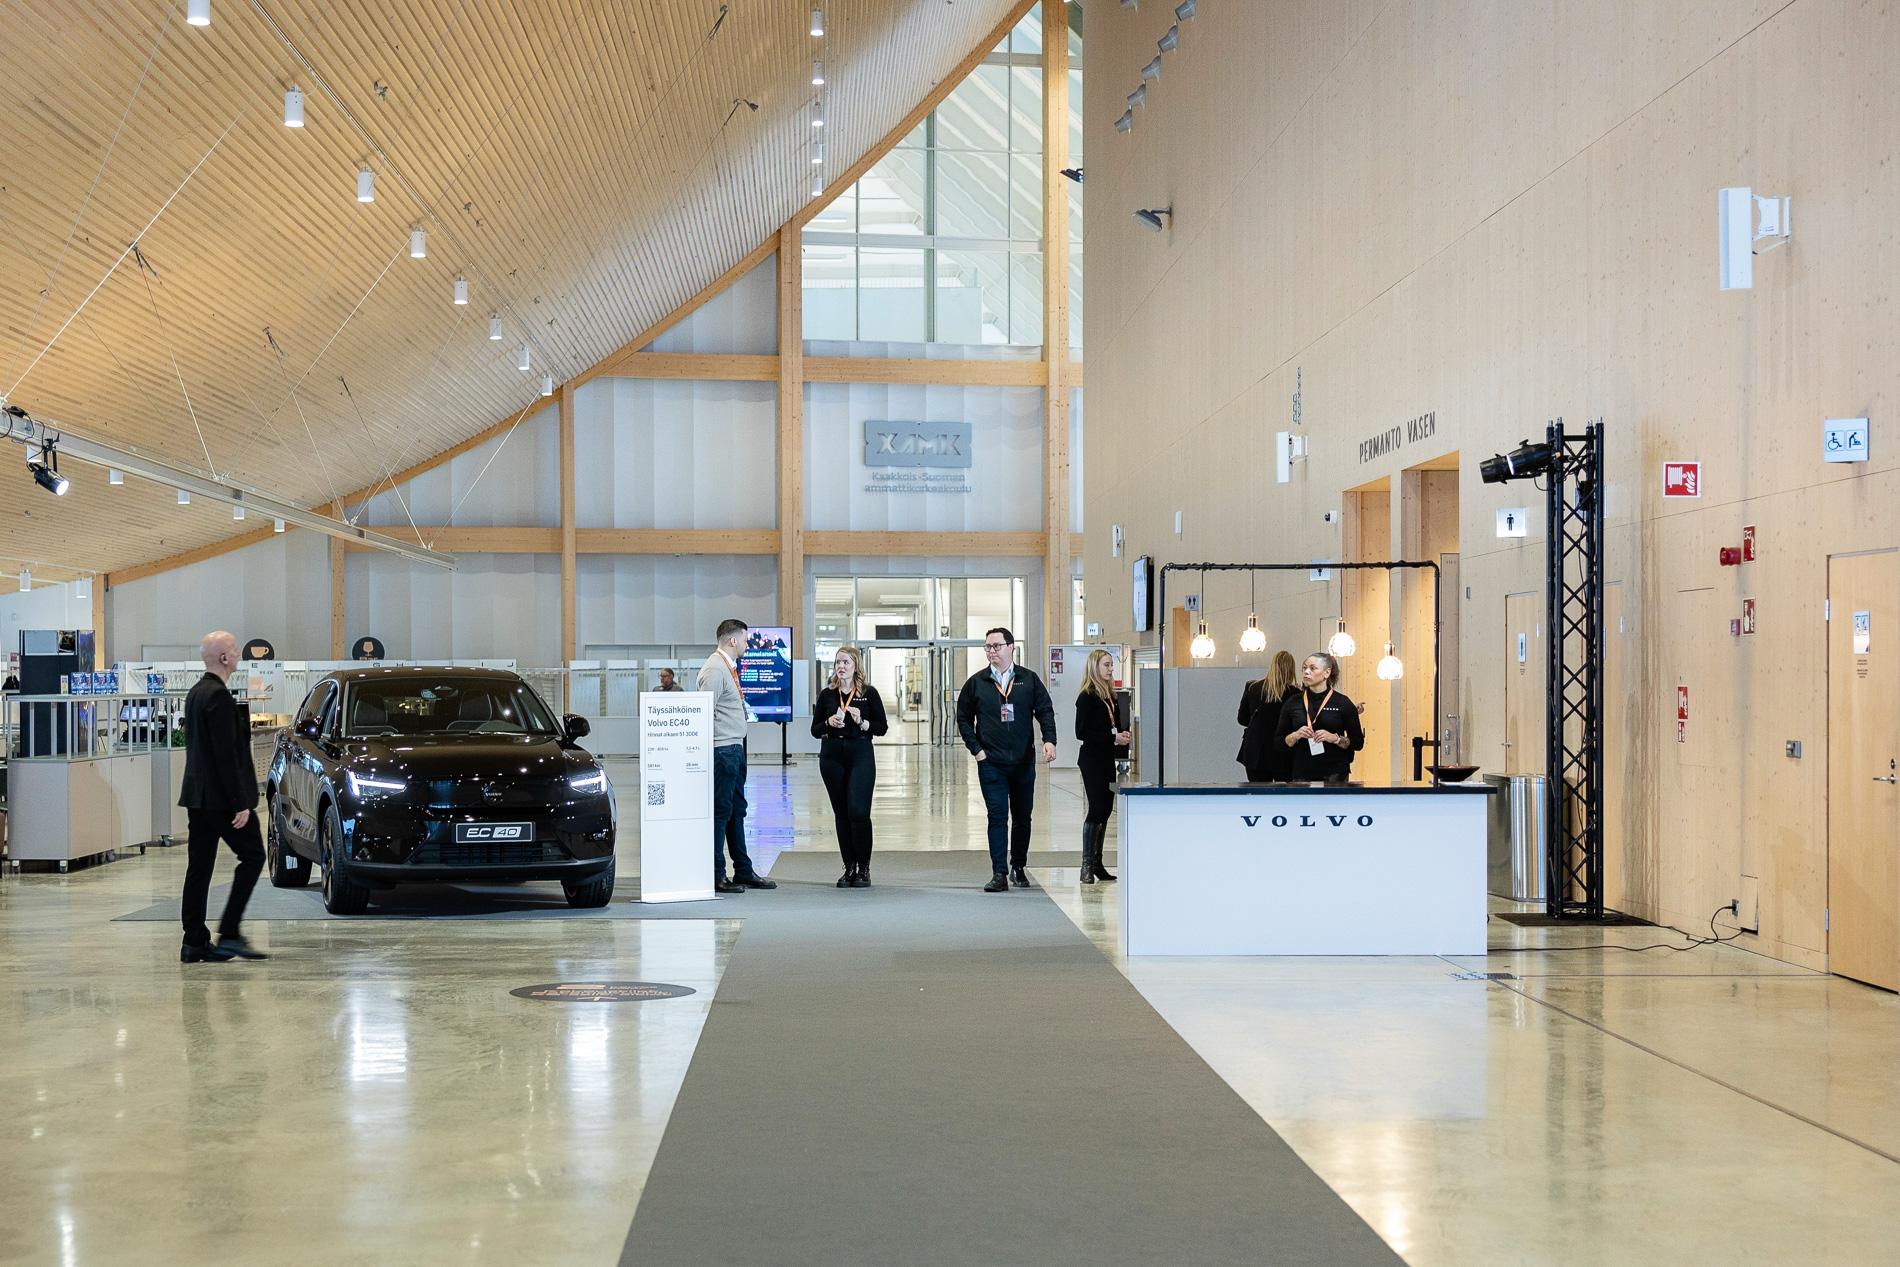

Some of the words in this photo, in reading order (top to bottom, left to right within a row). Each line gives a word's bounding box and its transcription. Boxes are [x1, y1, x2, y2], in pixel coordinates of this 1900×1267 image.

[876, 432, 962, 456] XAMK
[1359, 425, 1402, 465] PERMANTO
[1407, 411, 1435, 444] VASEN
[647, 705, 702, 716] Täyssähköinen
[647, 719, 668, 727] Volvo
[669, 718, 690, 727] EC40
[1240, 814, 1374, 828] VOLVO
